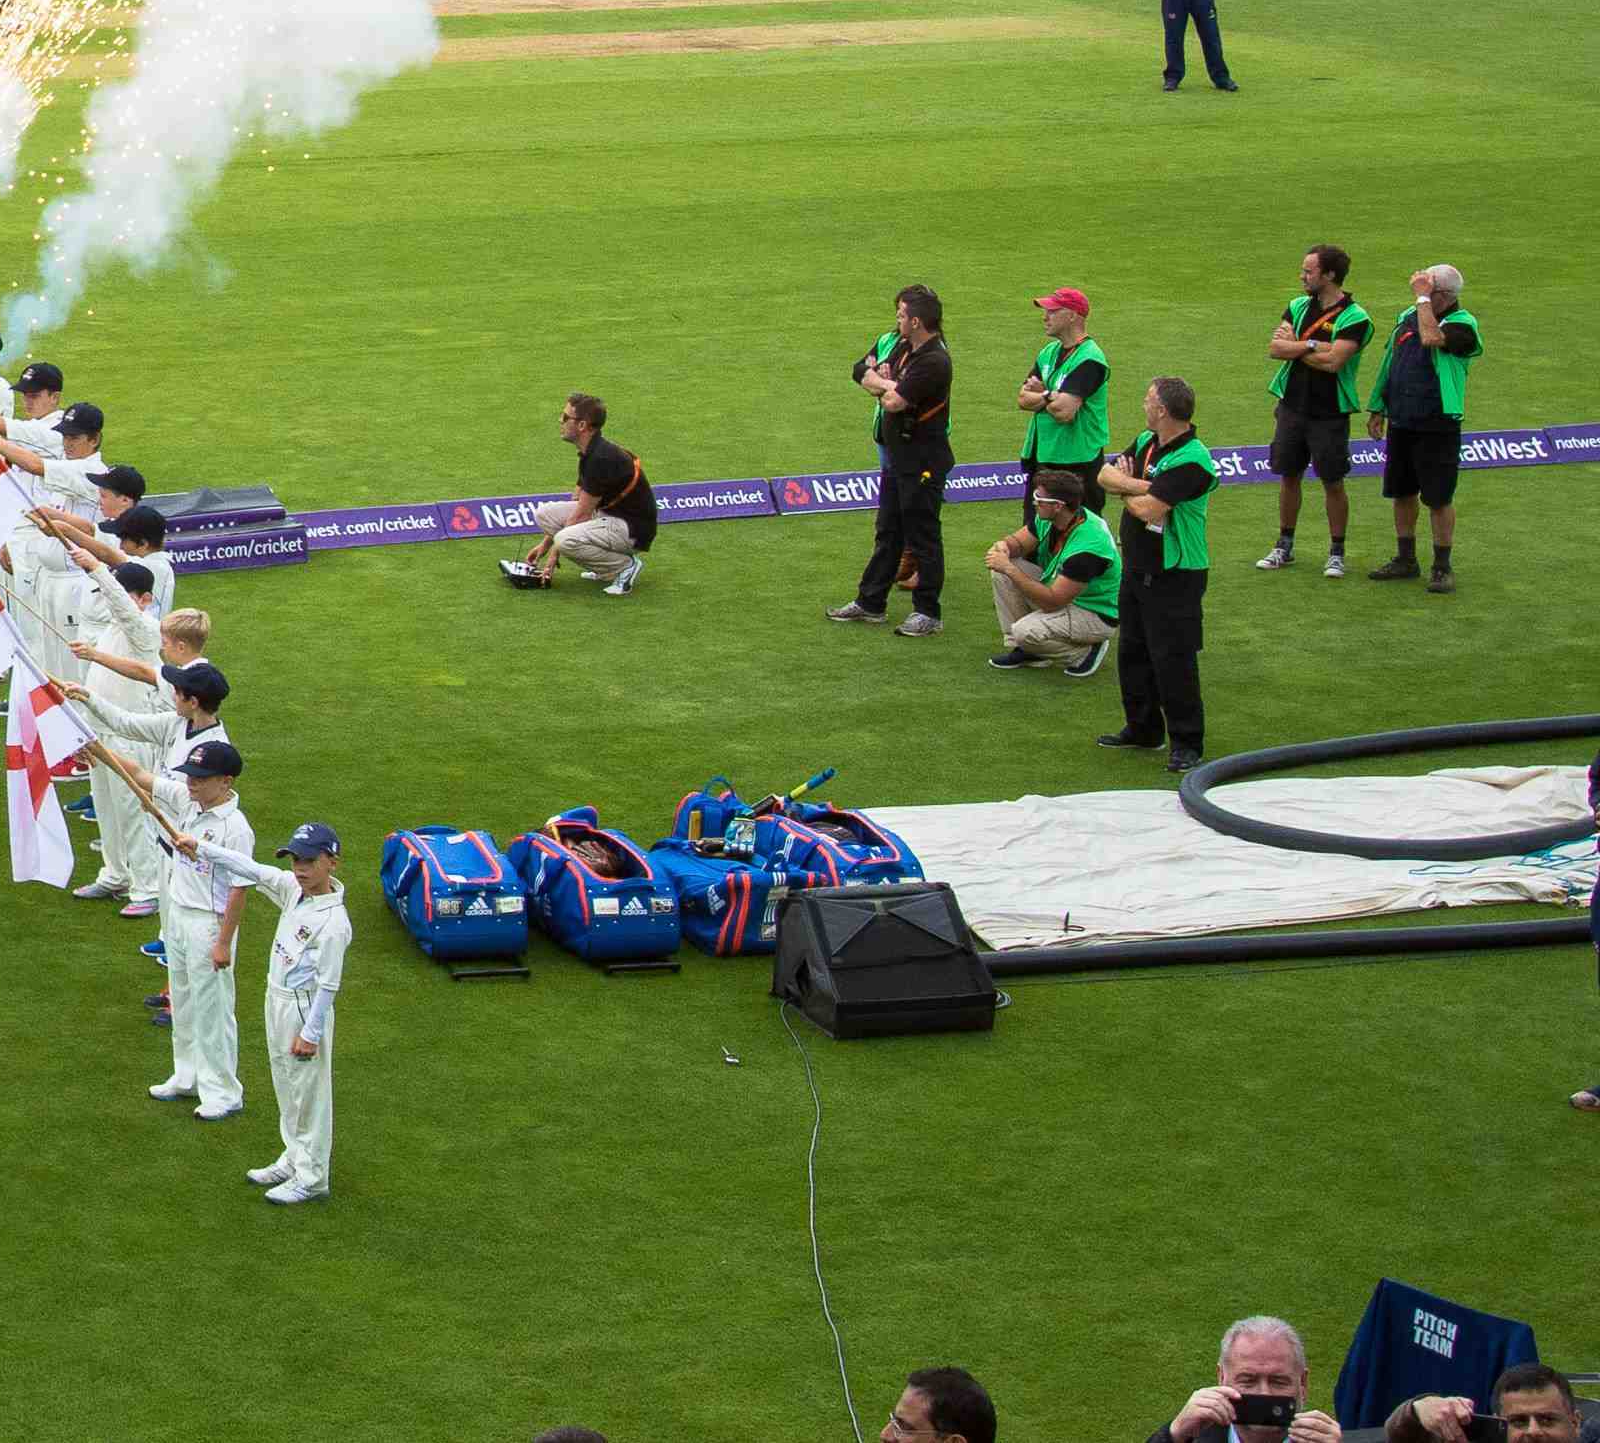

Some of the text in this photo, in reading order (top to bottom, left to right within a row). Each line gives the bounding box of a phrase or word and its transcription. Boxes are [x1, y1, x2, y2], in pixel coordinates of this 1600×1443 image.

[1555, 435, 1600, 452] natwes
[656, 487, 765, 512] st.com/cricket
[813, 472, 881, 504] NatW
[306, 513, 436, 539] west.com/cricket
[170, 536, 304, 564] twest.com/cricket
[1413, 1307, 1459, 1341] PITCH
[1412, 1324, 1454, 1358] TEAM
